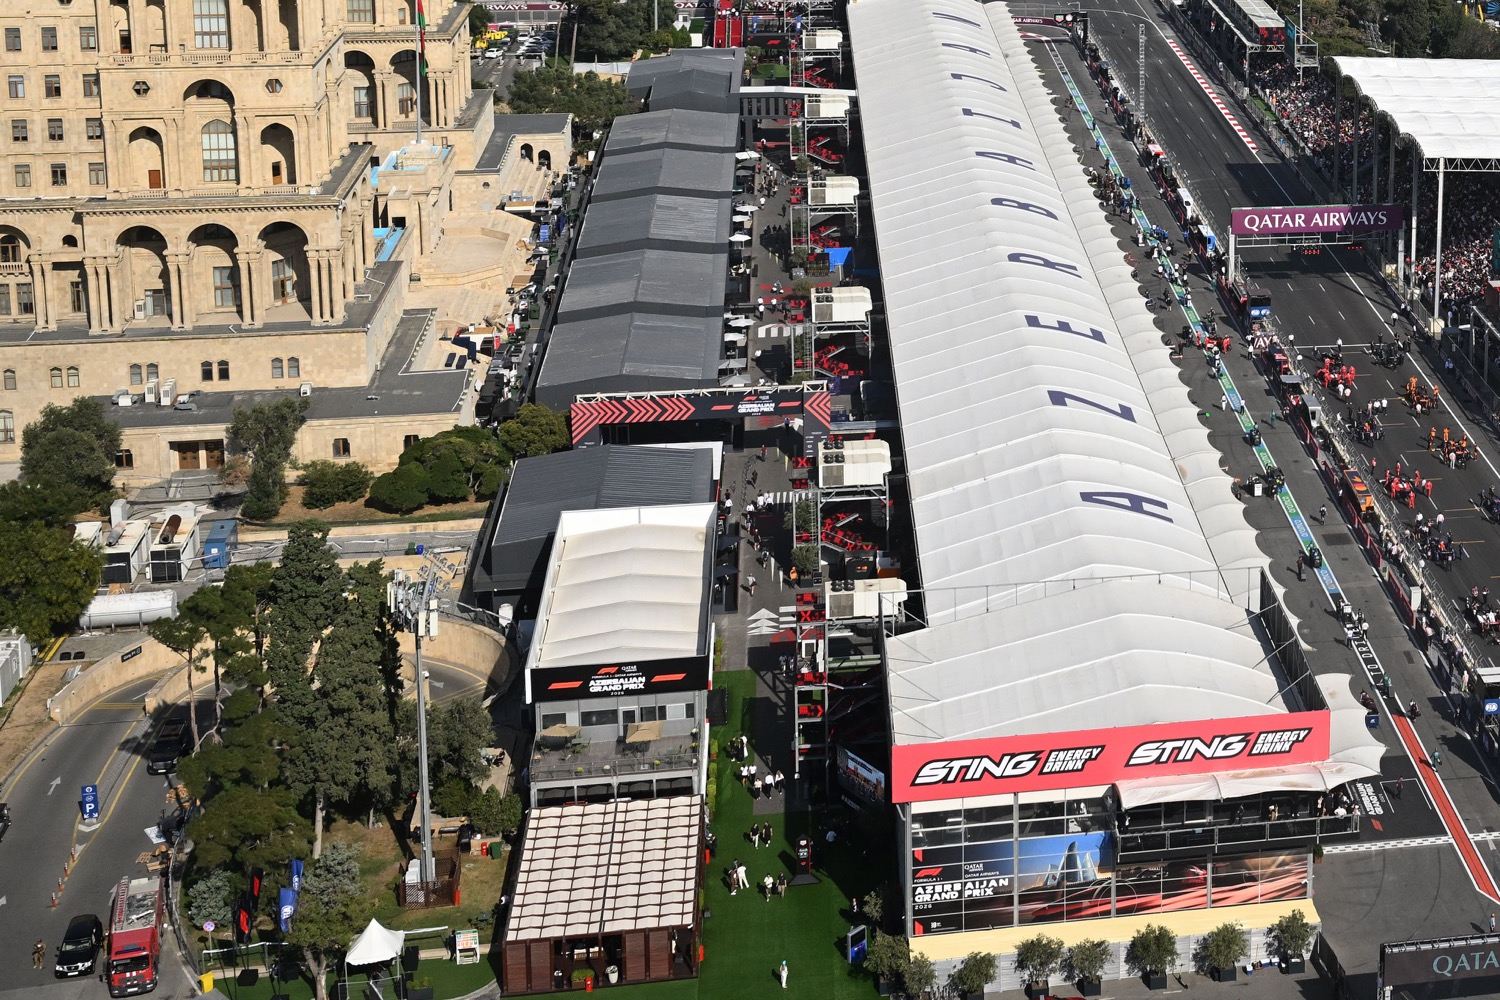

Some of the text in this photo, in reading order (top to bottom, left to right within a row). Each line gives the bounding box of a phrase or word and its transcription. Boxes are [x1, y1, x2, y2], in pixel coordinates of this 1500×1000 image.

[1244, 211, 1387, 231] QATAR AIRWAYS
[1367, 664, 1381, 676] TO
[589, 677, 646, 687] AZERBAIJAN
[1128, 729, 1309, 766] STING ENERGY DRINK
[914, 747, 1101, 784] STING ENERGY DRINK
[86, 803, 95, 813] P
[915, 878, 1009, 895] AZERBAIJAN
[915, 887, 994, 903] GRAND PRIX
